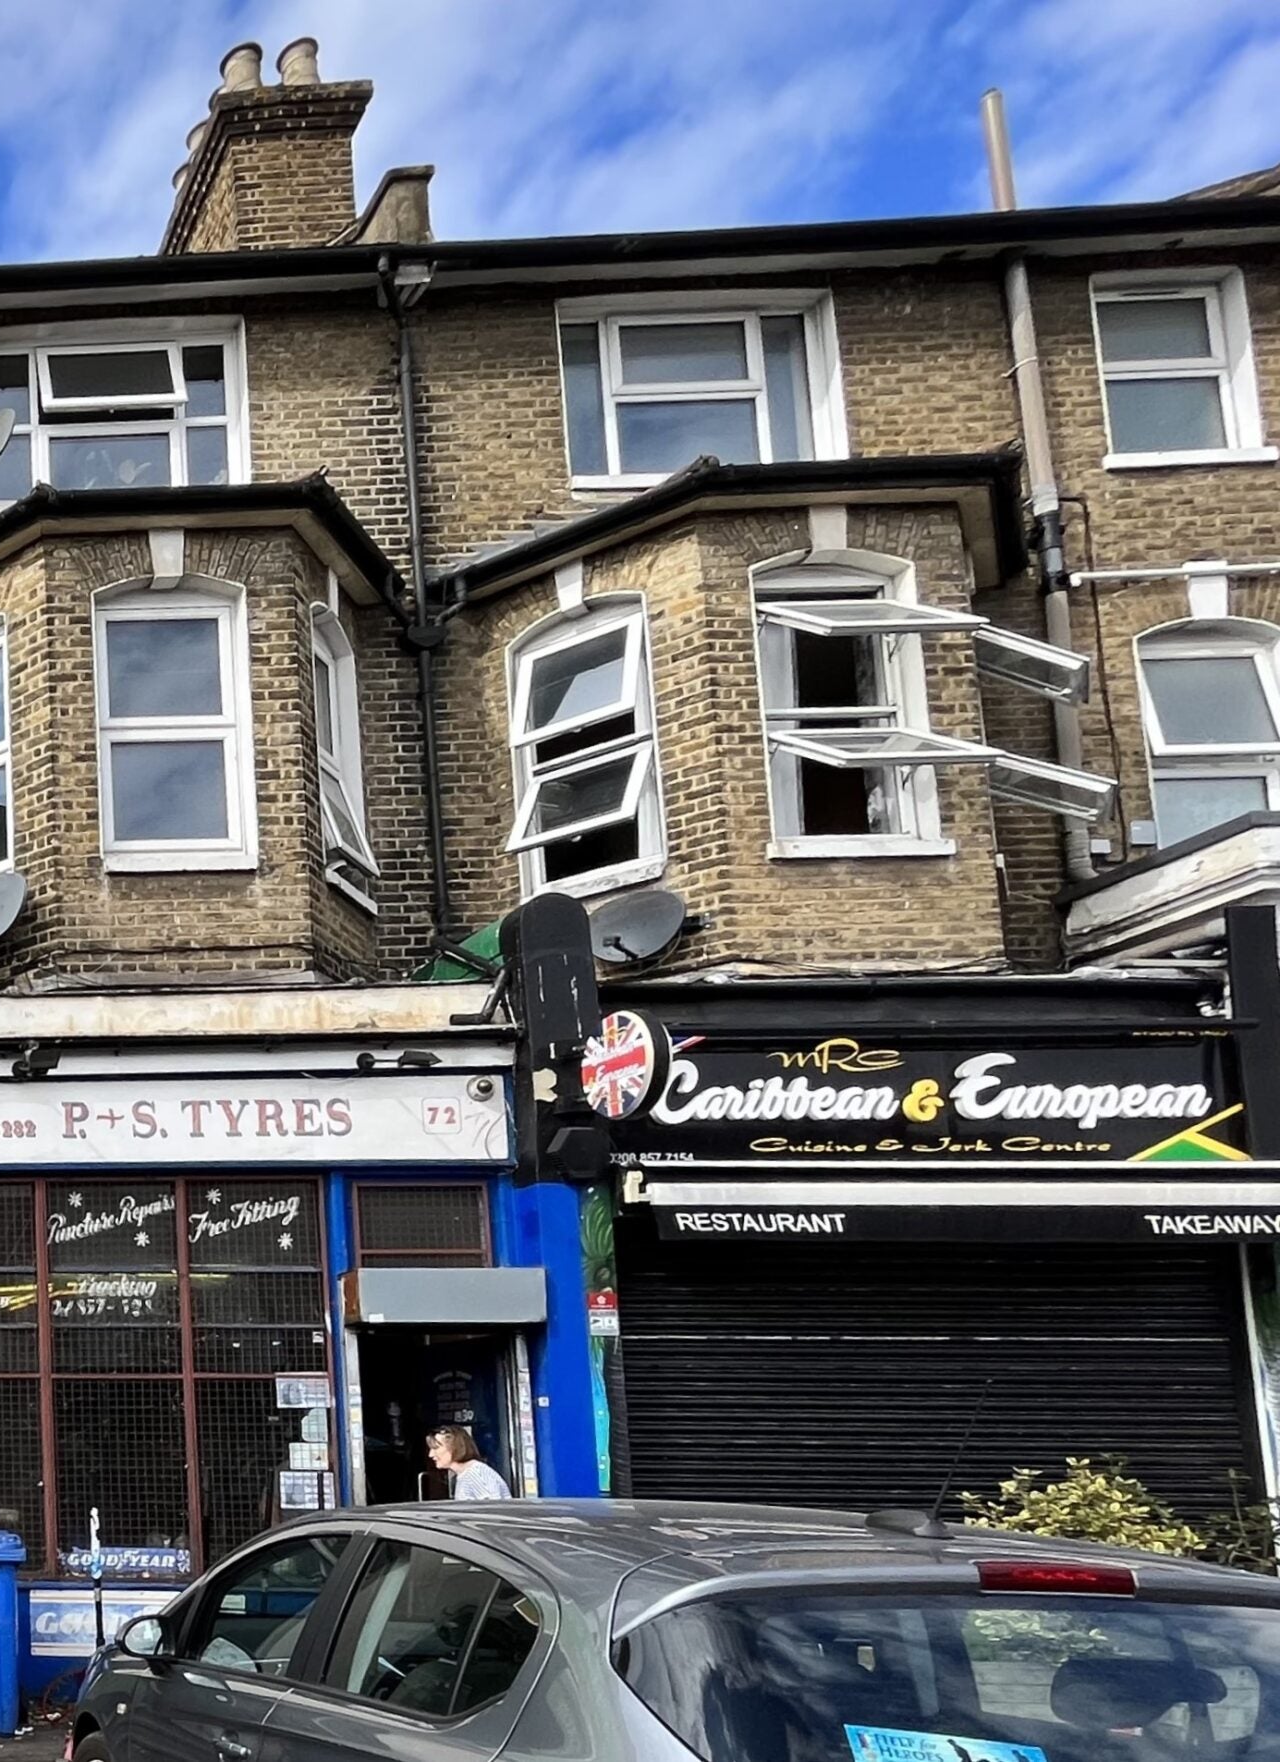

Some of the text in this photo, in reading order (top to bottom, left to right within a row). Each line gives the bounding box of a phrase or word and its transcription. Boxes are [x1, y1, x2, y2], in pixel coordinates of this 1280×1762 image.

[649, 1052, 1213, 1130] Caribbean & European
[181, 1098, 353, 1138] TYRES
[426, 1106, 457, 1125] 72
[749, 1136, 868, 1153] Cuisine
[911, 1136, 993, 1153] Jerk
[1001, 1136, 1113, 1153] Centre
[639, 1152, 662, 1161] 857
[665, 1152, 695, 1162] 7154
[47, 1212, 115, 1246] Puncture
[188, 1196, 301, 1244] Free Fitting
[675, 1213, 847, 1233] RESTAURANT
[875, 1732, 916, 1748] HELP
